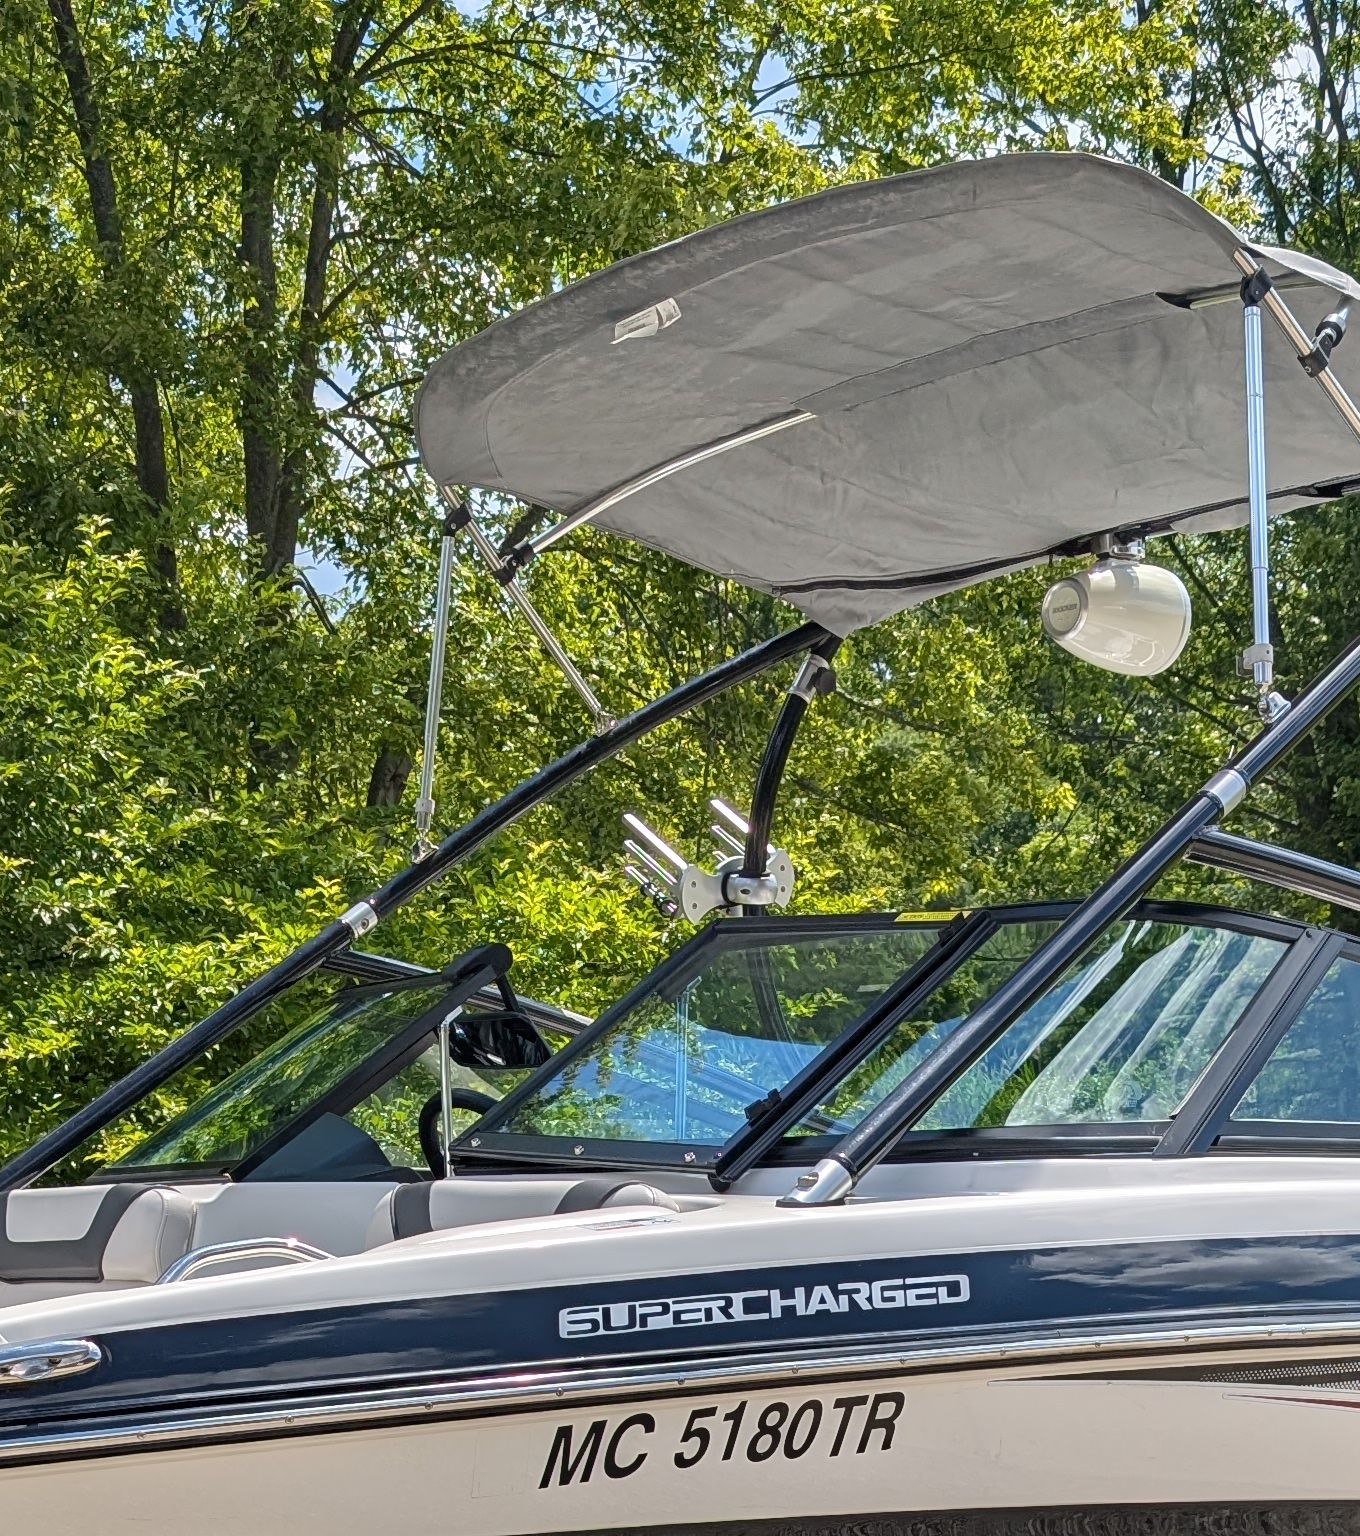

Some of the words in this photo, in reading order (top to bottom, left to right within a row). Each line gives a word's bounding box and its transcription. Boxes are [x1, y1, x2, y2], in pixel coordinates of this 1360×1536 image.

[559, 1274, 970, 1338] SUPERCHARGED
[538, 1412, 656, 1490] MC
[673, 1391, 905, 1469] 5180TR
